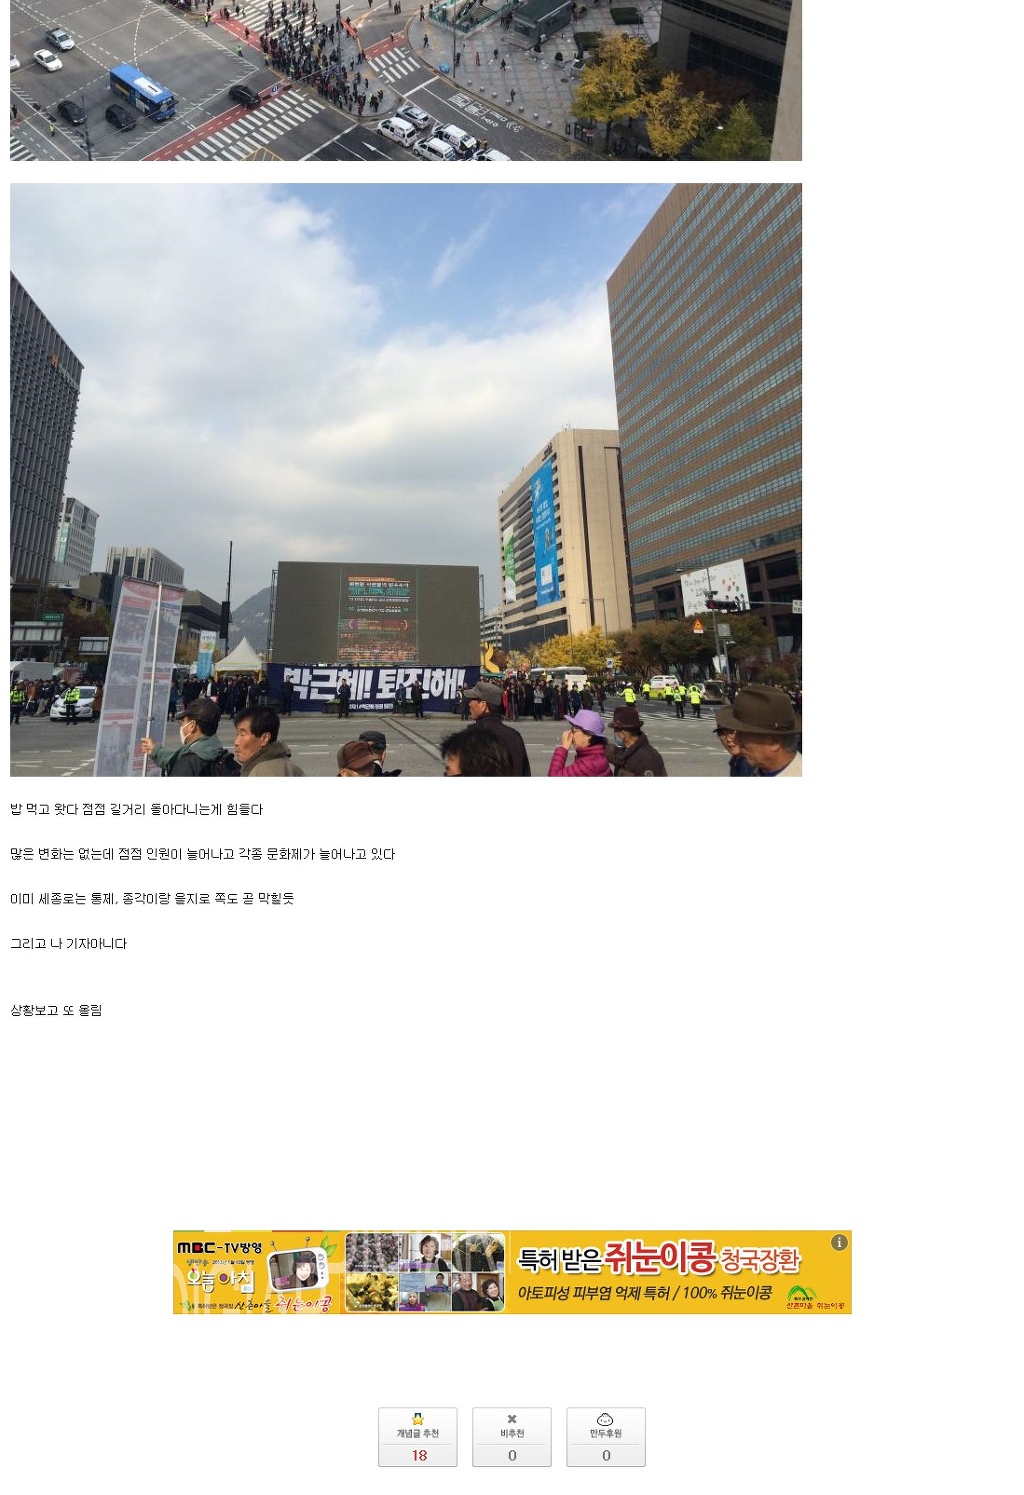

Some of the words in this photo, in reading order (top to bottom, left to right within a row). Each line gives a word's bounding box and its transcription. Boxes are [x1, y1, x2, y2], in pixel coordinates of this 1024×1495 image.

[10, 803, 23, 816] 밥
[26, 803, 51, 816] 먹고
[54, 803, 79, 816] 왓다
[82, 803, 106, 816] 점점
[110, 803, 146, 816] 길거리
[150, 803, 222, 816] 돌아다니는게
[226, 803, 264, 816] 힘들다
[10, 847, 35, 861] 많은
[38, 847, 75, 861] 변화는
[78, 847, 114, 861] 없는데
[118, 847, 142, 861] 점점
[146, 847, 182, 861] 인원이
[186, 847, 235, 861] 늘어나고
[238, 847, 263, 861] 각종
[266, 847, 316, 861] 문화제가
[318, 847, 367, 861] 늘어나고
[371, 847, 396, 861] 있다
[10, 892, 34, 906] 이미
[38, 892, 87, 906] 세종로는
[90, 892, 119, 906] 통제,
[122, 892, 172, 906] 종각이랑
[174, 892, 211, 906] 을지로
[214, 892, 239, 906] 쪽도
[242, 892, 255, 906] 곧
[258, 892, 295, 906] 막힐듯
[10, 937, 47, 950] 그리고
[50, 937, 63, 950] 나
[66, 937, 128, 950] 기자아니다
[10, 1004, 59, 1017] 상황보고
[62, 1004, 75, 1017] 또
[78, 1004, 103, 1017] 올림
[396, 1428, 421, 1439] 개념글
[422, 1428, 440, 1439] 추천
[500, 1428, 525, 1439] 비추천
[590, 1428, 623, 1439] 만두후원
[412, 1449, 428, 1462] 18
[508, 1449, 517, 1462] 0
[602, 1449, 611, 1462] 0
